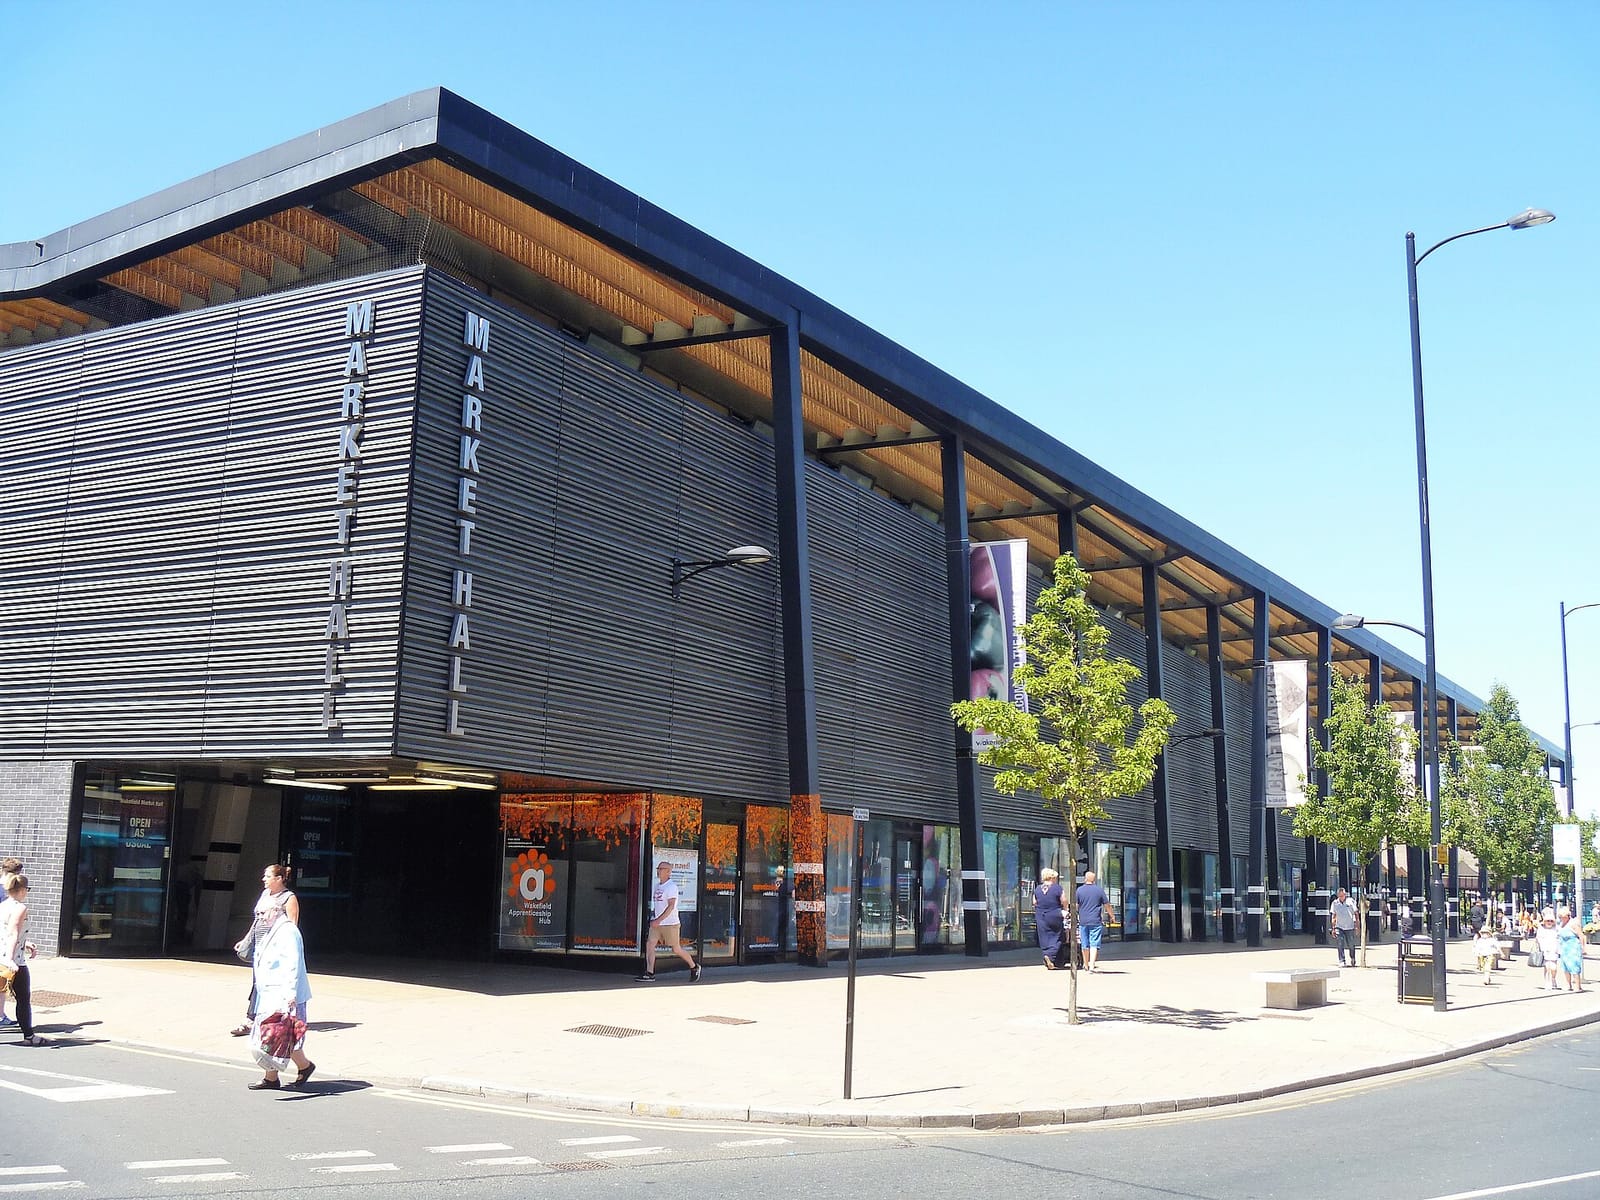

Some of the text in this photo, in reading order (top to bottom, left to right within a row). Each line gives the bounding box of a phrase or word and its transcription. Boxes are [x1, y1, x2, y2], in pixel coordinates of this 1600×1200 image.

[322, 300, 376, 729] MARKET HALL
[446, 311, 490, 736] MARKET HALL
[1266, 666, 1280, 733] MARKET
[1267, 736, 1283, 791] CRAFT
[129, 817, 151, 828] OPEN
[134, 828, 145, 838] AS
[303, 831, 321, 841] OPEN
[519, 868, 545, 901] a
[523, 901, 552, 910] Wakefield
[508, 908, 552, 918] Apprenticeship
[538, 917, 552, 925] Hub
